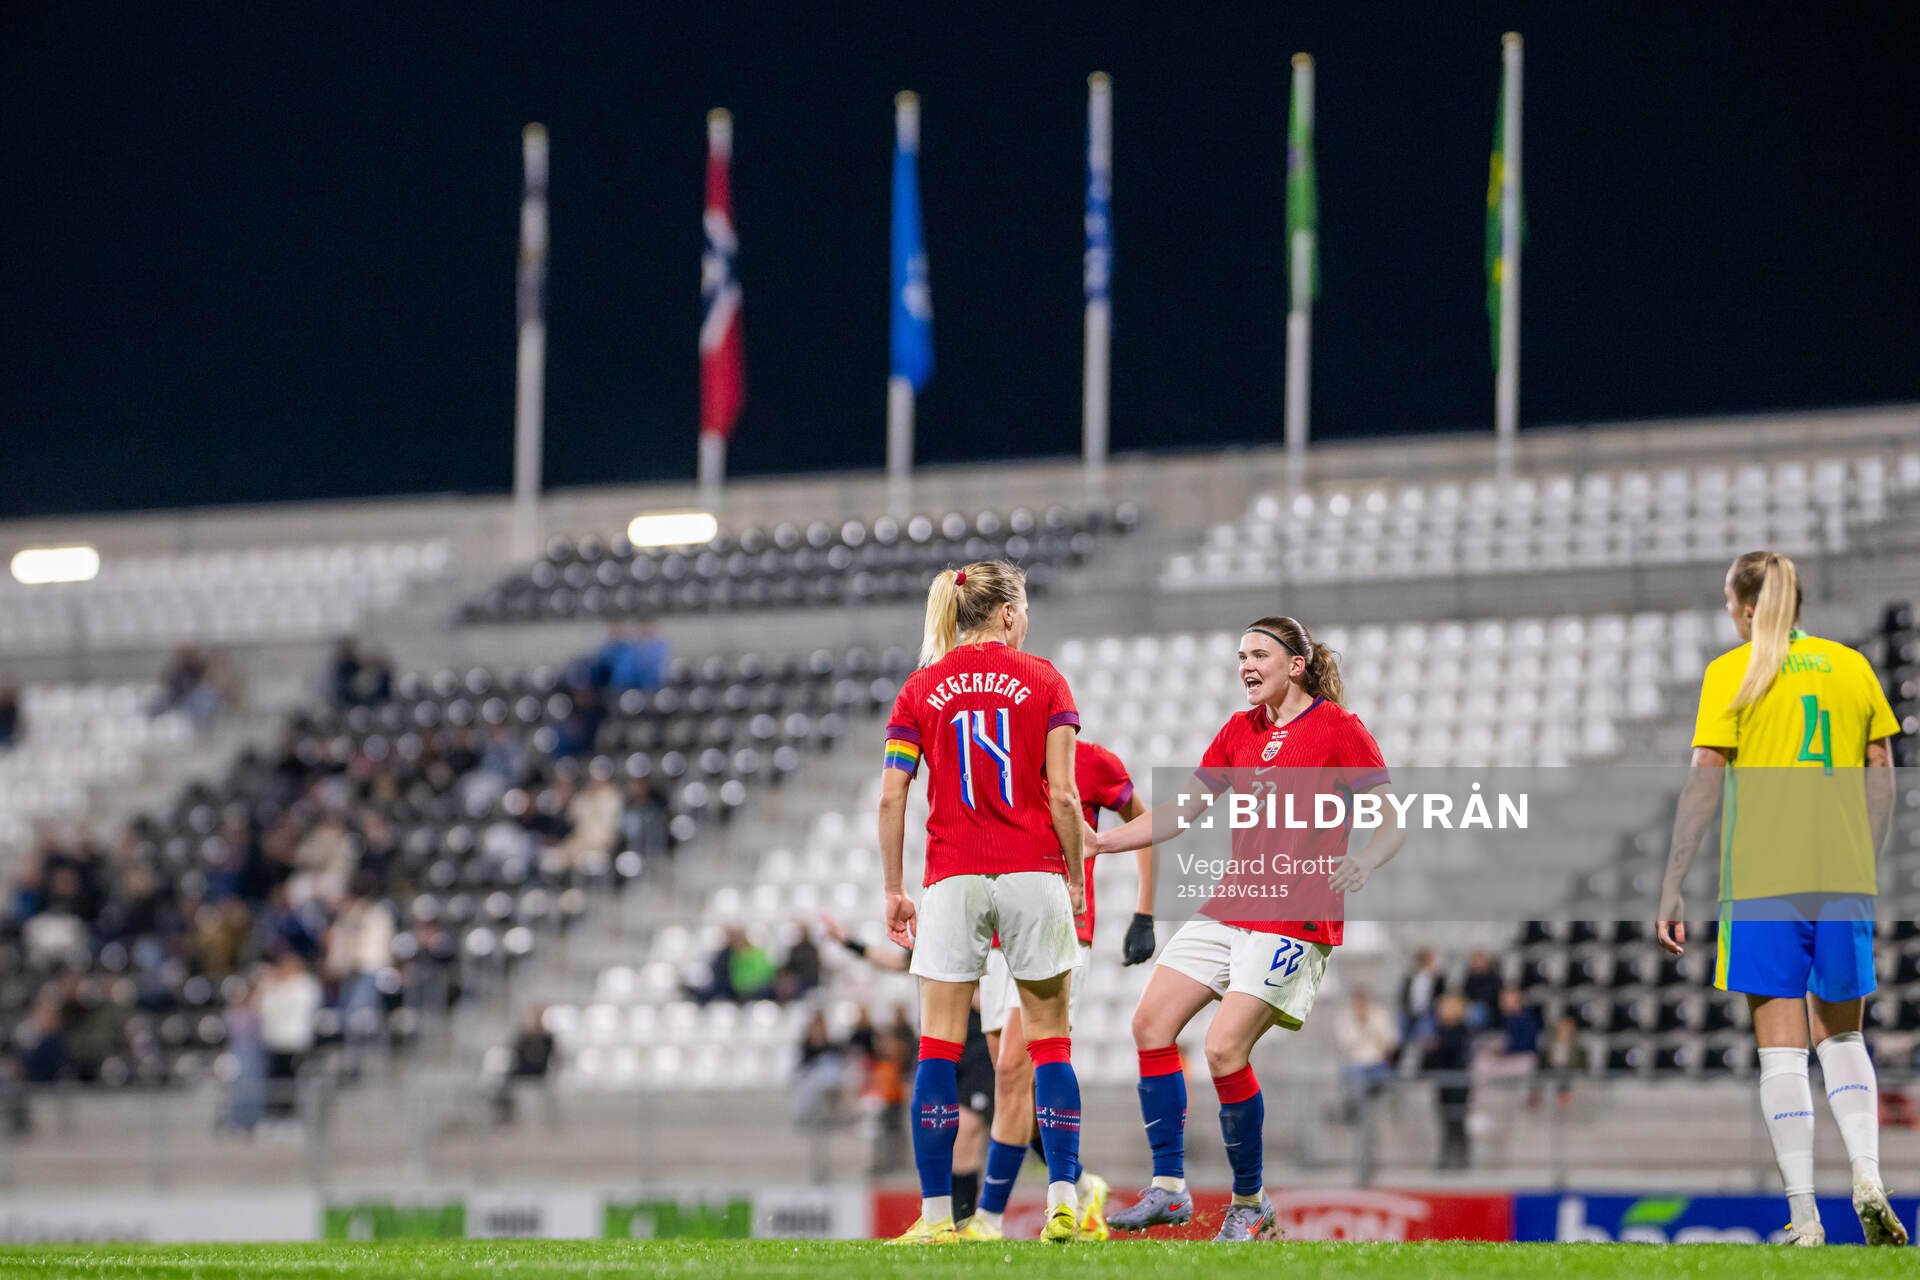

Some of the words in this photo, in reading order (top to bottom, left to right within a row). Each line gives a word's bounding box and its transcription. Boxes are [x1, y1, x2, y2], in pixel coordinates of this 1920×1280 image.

[926, 673, 1031, 711] HEGERBERG
[949, 708, 1013, 810] 14
[1798, 695, 1833, 776] 4
[1270, 938, 1303, 977] 22
